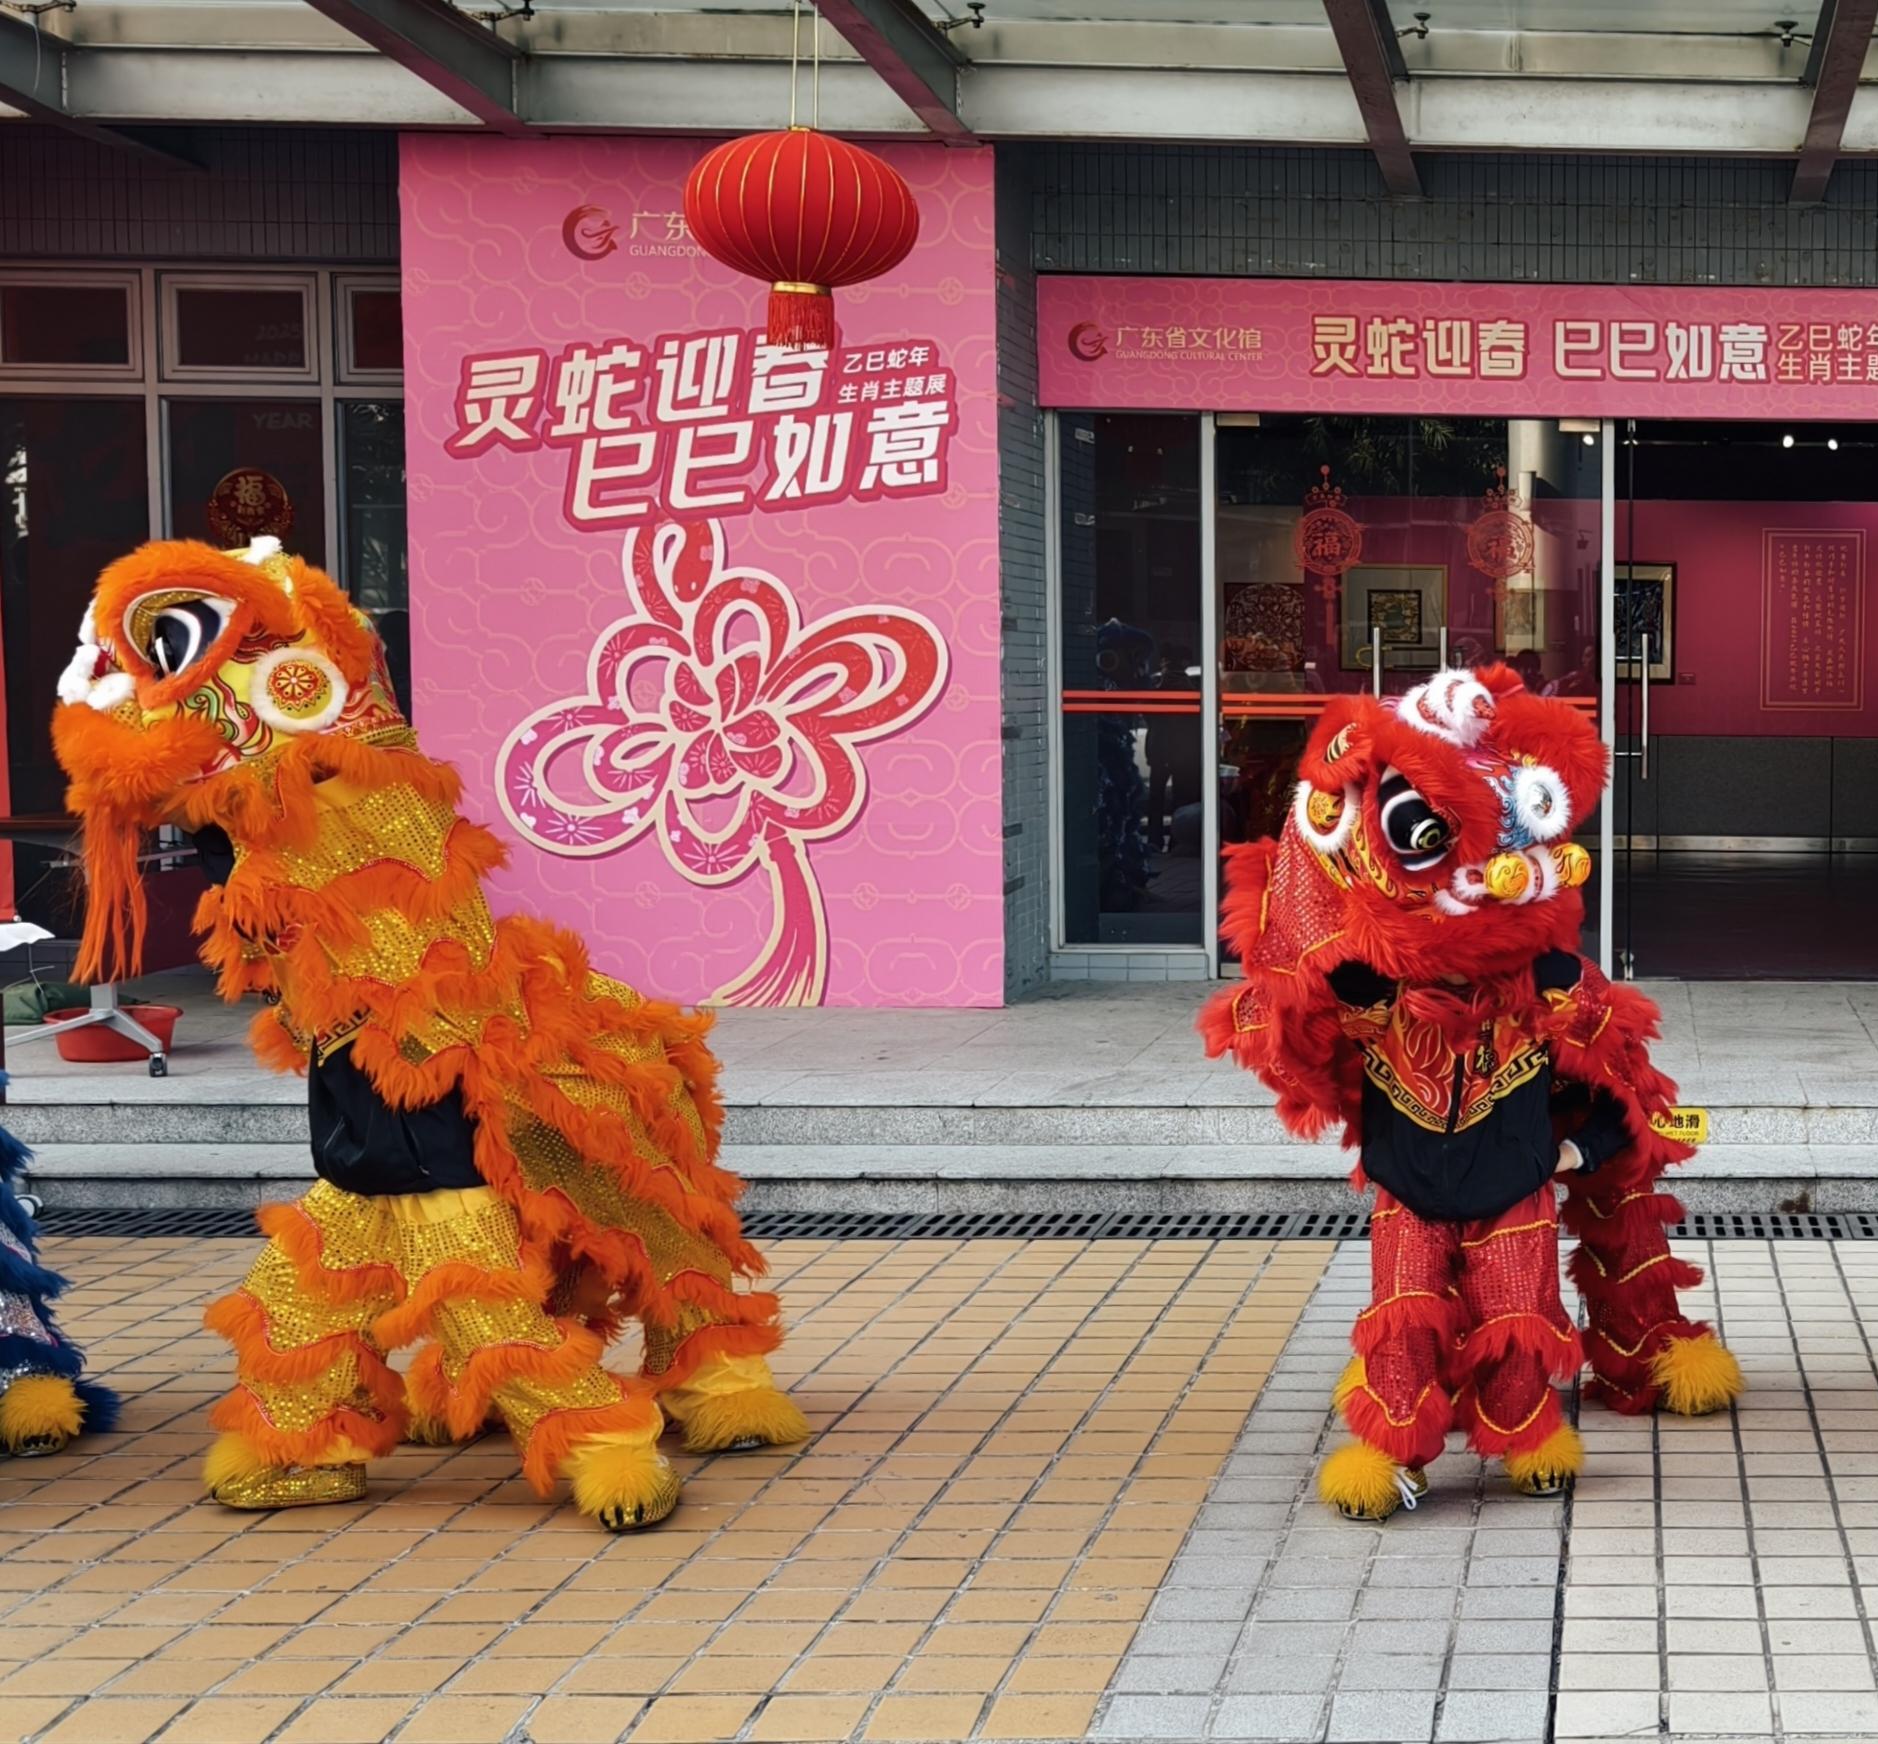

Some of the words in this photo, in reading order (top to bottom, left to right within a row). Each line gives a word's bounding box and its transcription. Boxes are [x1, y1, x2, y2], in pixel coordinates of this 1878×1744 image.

[1116, 327, 1262, 348] 广东省文化馆
[1312, 316, 1526, 377] 灵蛇迎春
[1116, 350, 1178, 361] GUANGDONG
[1180, 351, 1225, 361] CULTURAL
[1227, 352, 1263, 361] CENTER
[457, 334, 831, 446] 灵蛇迎春
[837, 373, 947, 404] 生肖主题展
[252, 412, 313, 431] YEAR
